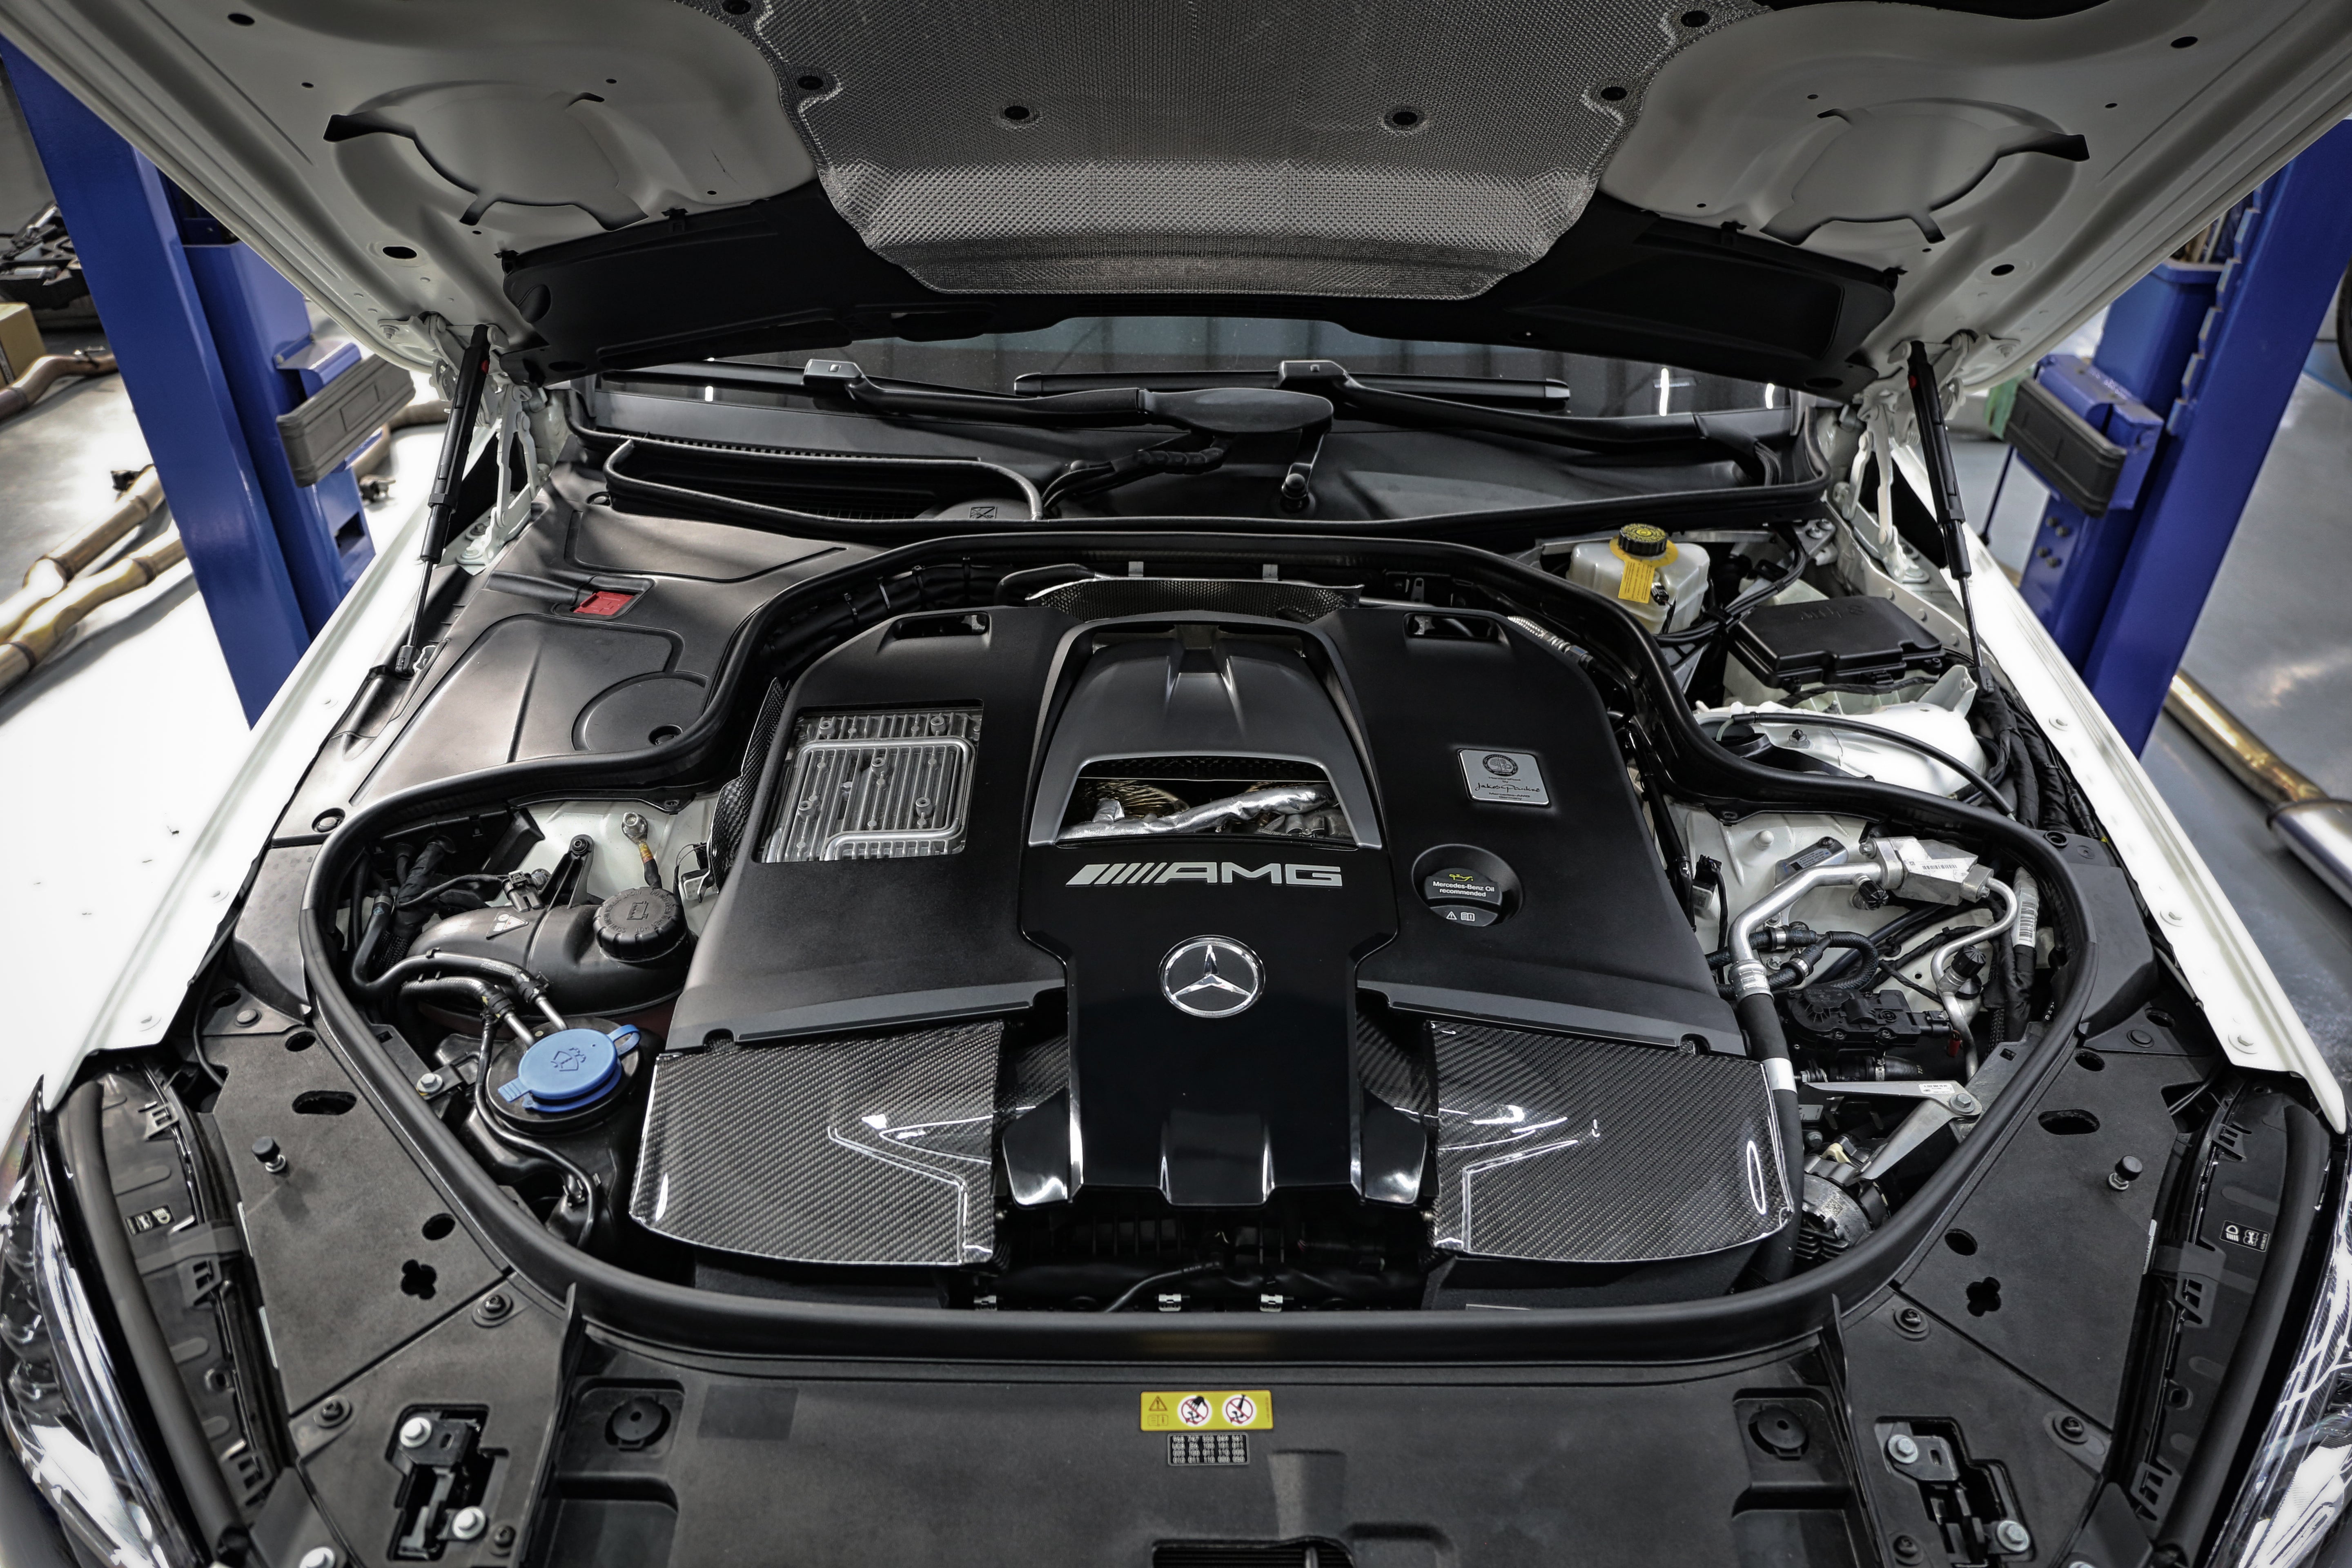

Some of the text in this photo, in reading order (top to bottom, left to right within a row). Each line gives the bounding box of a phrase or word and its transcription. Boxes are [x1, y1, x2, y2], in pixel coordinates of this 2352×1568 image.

[1155, 862, 1343, 886] AMG
[1433, 881, 1484, 891] Mercedes-Benz
[1439, 889, 1486, 897] recommended
[658, 894, 669, 902] NOT
